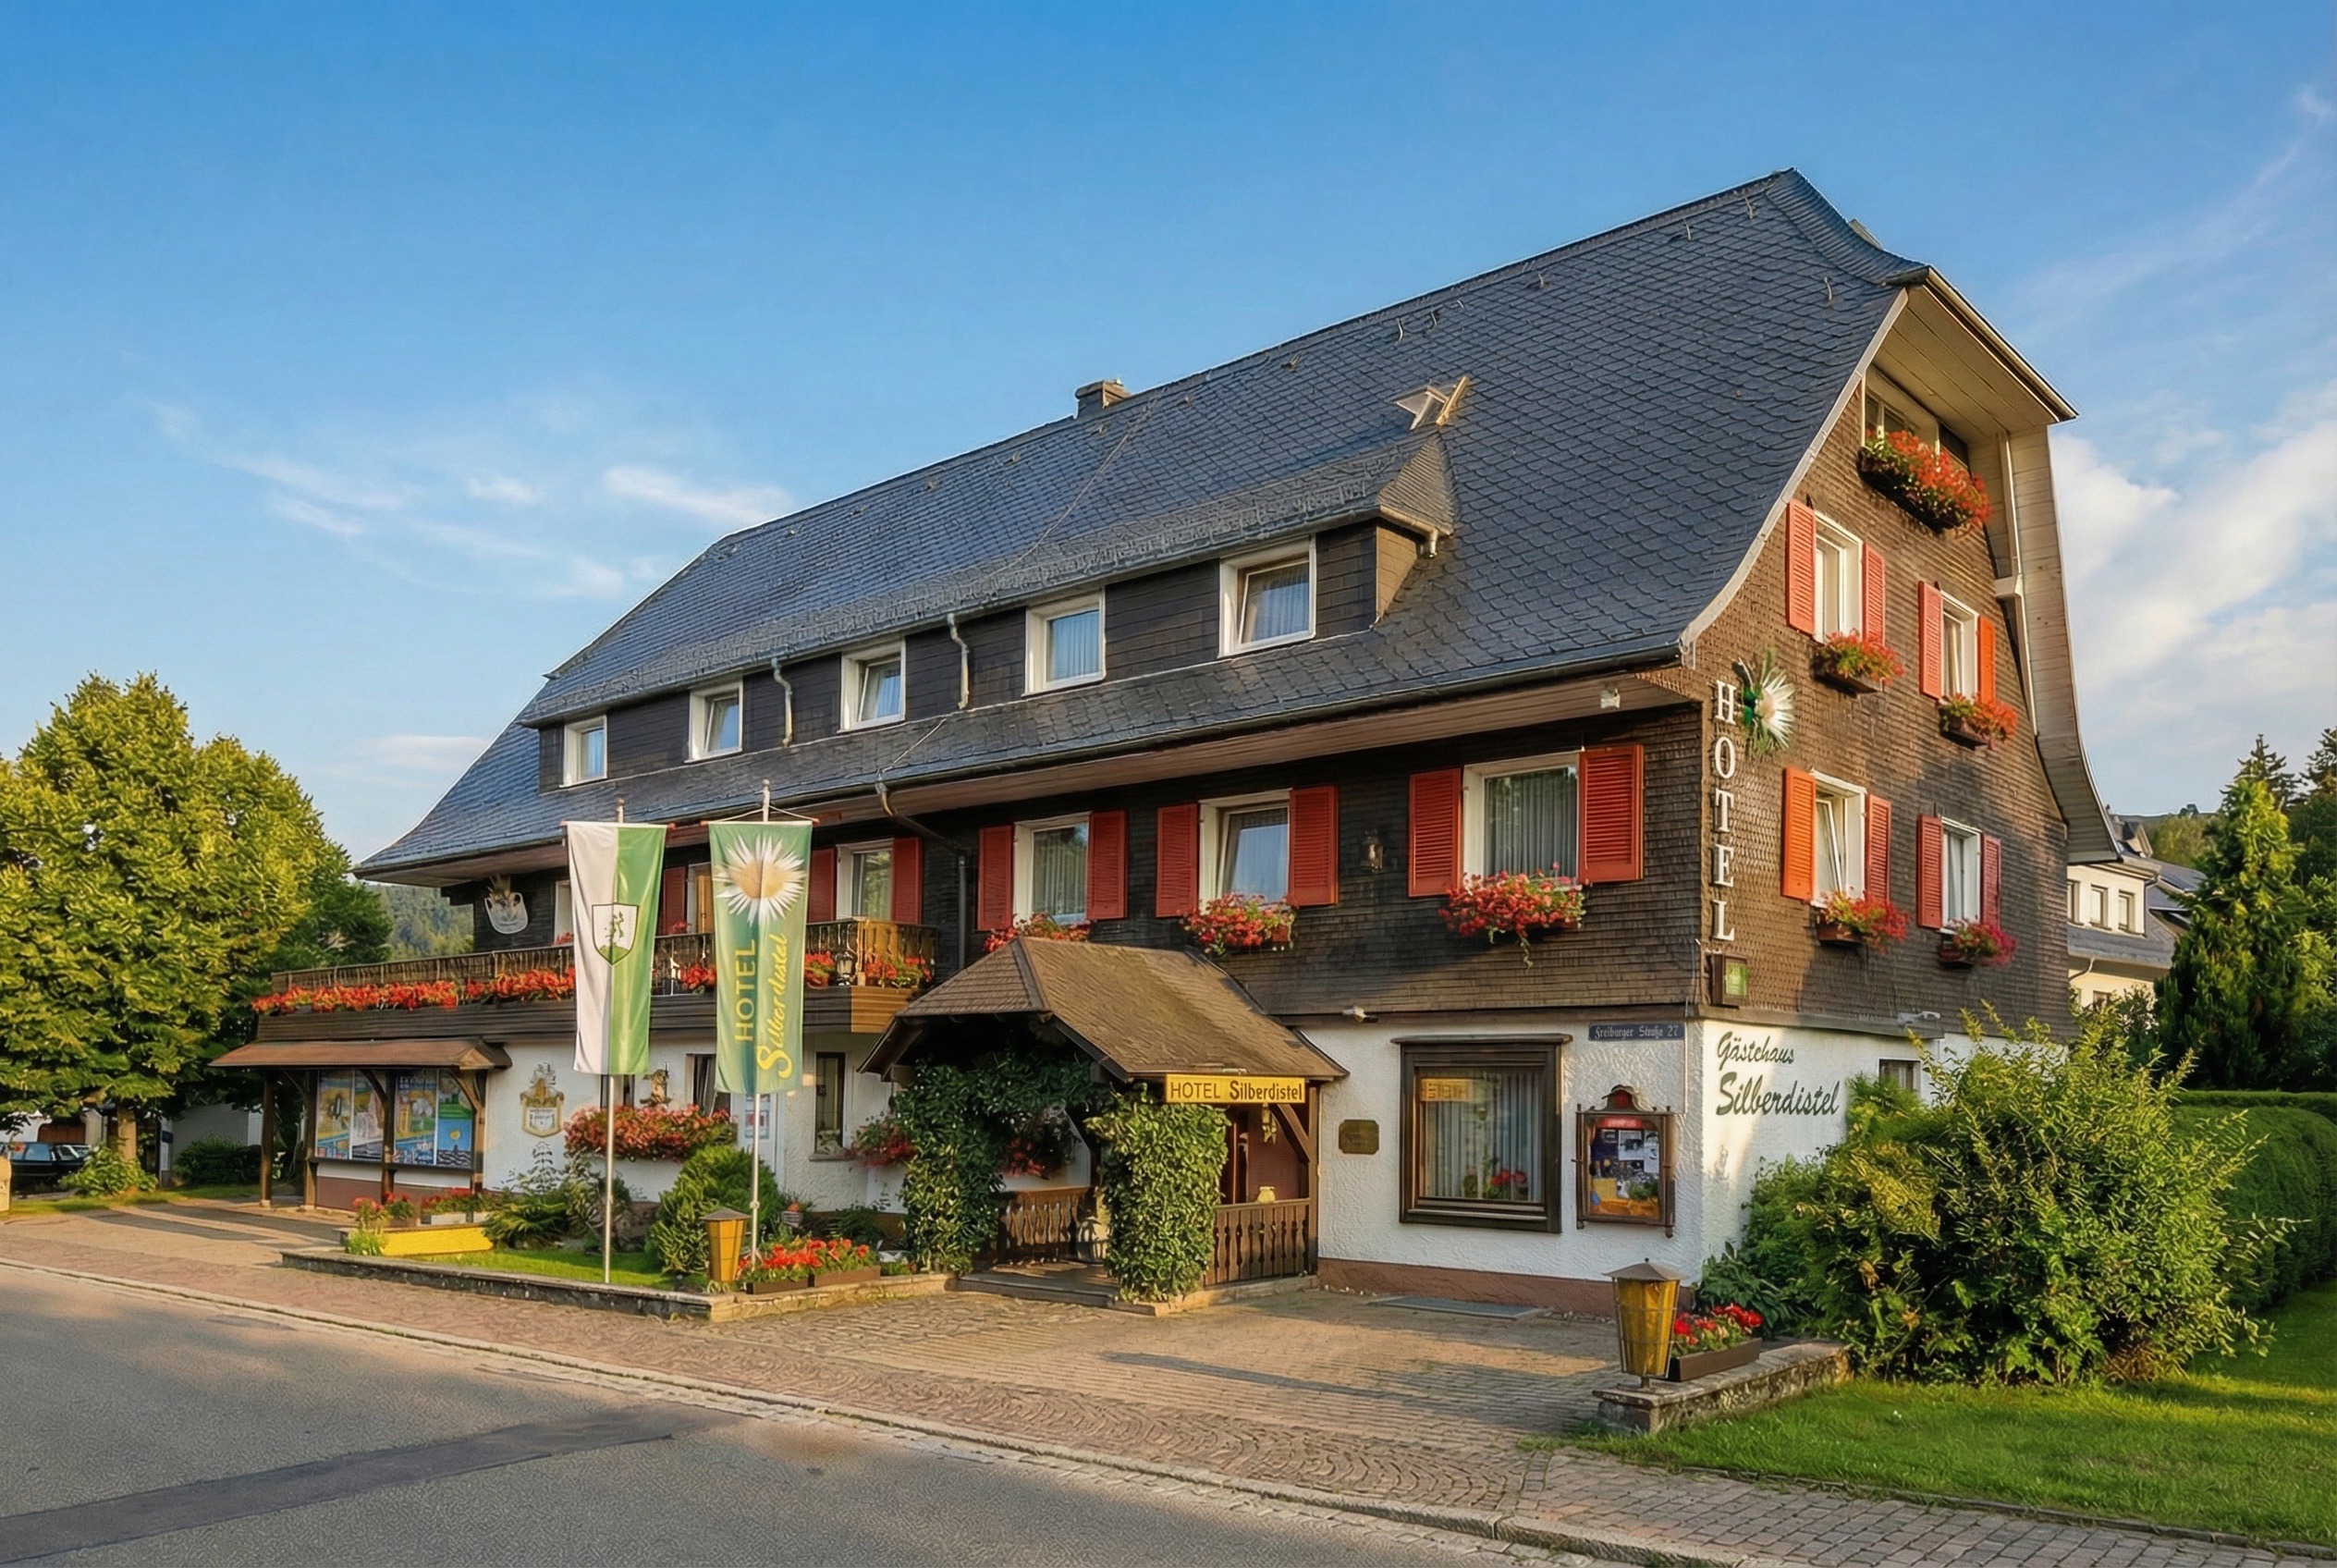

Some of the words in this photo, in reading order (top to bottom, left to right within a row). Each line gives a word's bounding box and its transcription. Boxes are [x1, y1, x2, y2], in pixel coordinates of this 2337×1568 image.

[1715, 680, 1737, 941] HOTEL
[734, 938, 756, 1042] HOTEL
[1595, 1025, 1633, 1039] Freiburger
[1638, 1025, 1663, 1038] Straße
[1667, 1025, 1679, 1036] 27
[1717, 1031, 1794, 1071] Gästehaus
[1170, 1082, 1220, 1099] HOTEL
[1230, 1080, 1303, 1100] Silberdistel
[1716, 1072, 1841, 1116] Silberdistel
